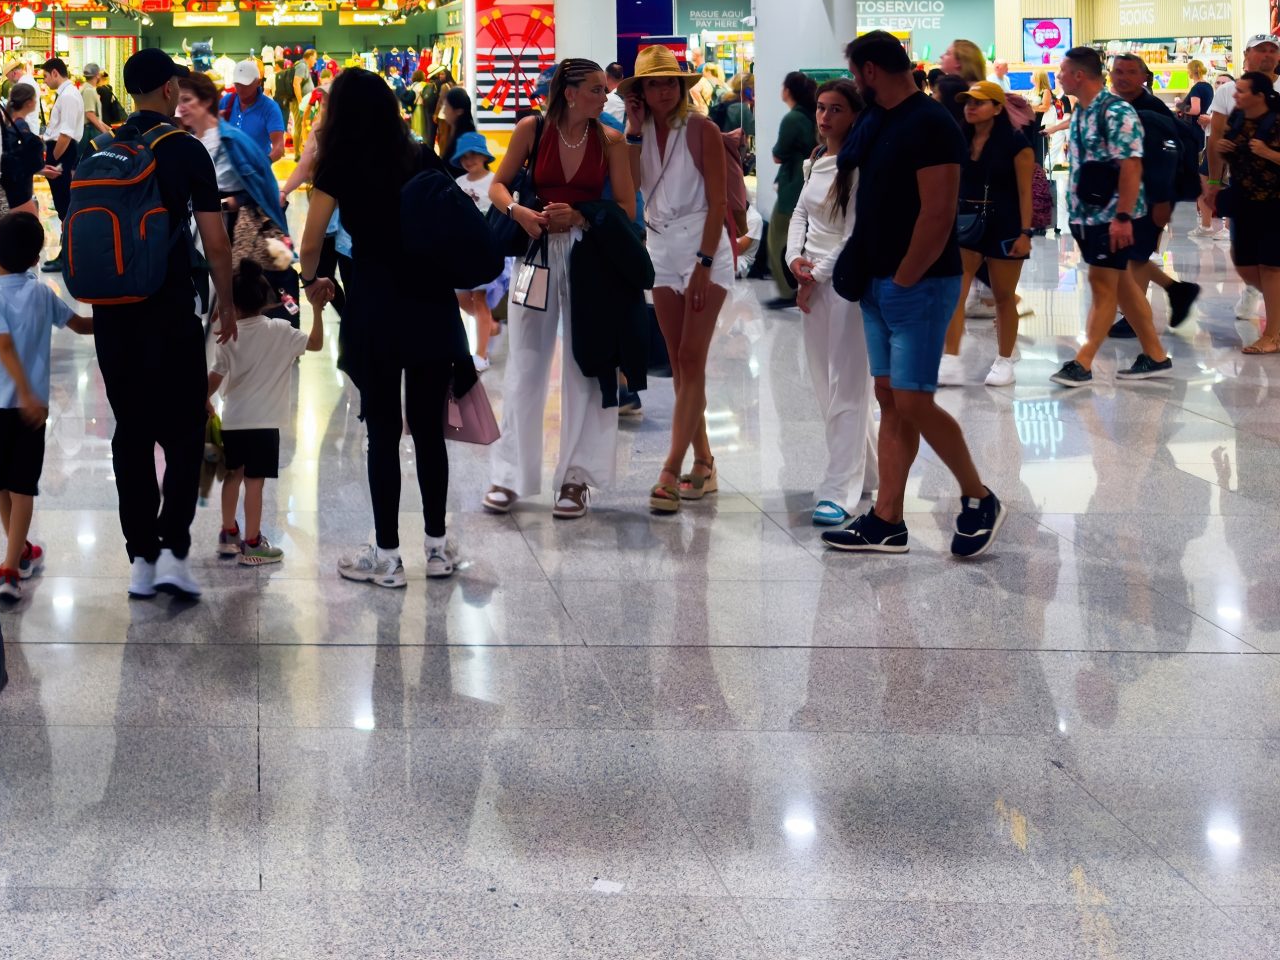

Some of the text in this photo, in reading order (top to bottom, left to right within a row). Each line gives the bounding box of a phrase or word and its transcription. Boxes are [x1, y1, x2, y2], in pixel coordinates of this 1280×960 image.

[689, 10, 719, 18] PAGUE
[1119, 8, 1156, 26] BOOKS
[695, 20, 738, 28] PAY HERE
[879, 17, 941, 29] SERVICE
